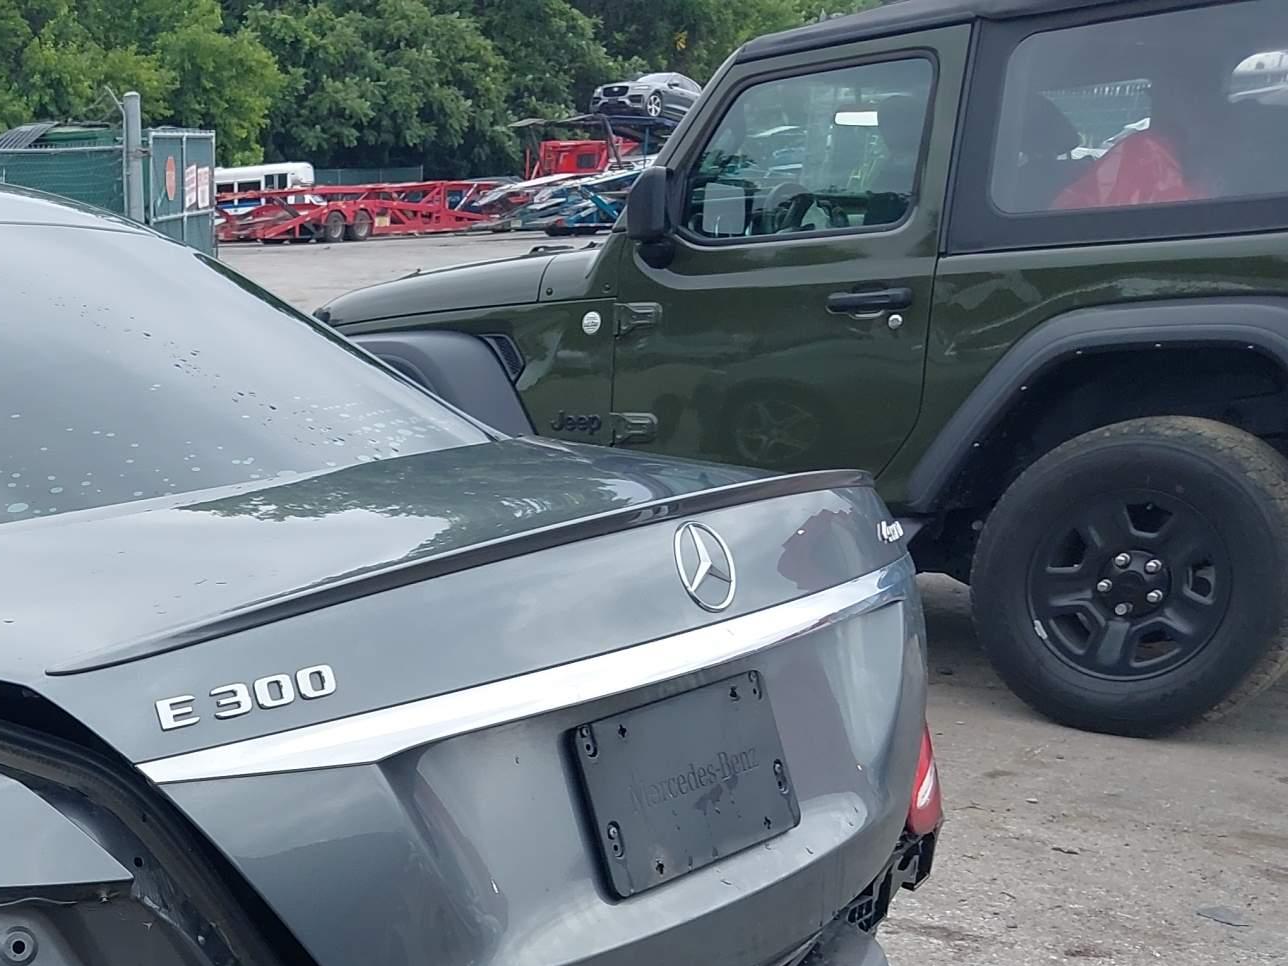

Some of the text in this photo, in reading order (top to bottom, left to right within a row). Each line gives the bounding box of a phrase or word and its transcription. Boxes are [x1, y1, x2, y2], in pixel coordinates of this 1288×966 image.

[550, 411, 601, 438] Jeep
[155, 664, 337, 732] E 300
[628, 747, 760, 812] Mercedes-Benz
